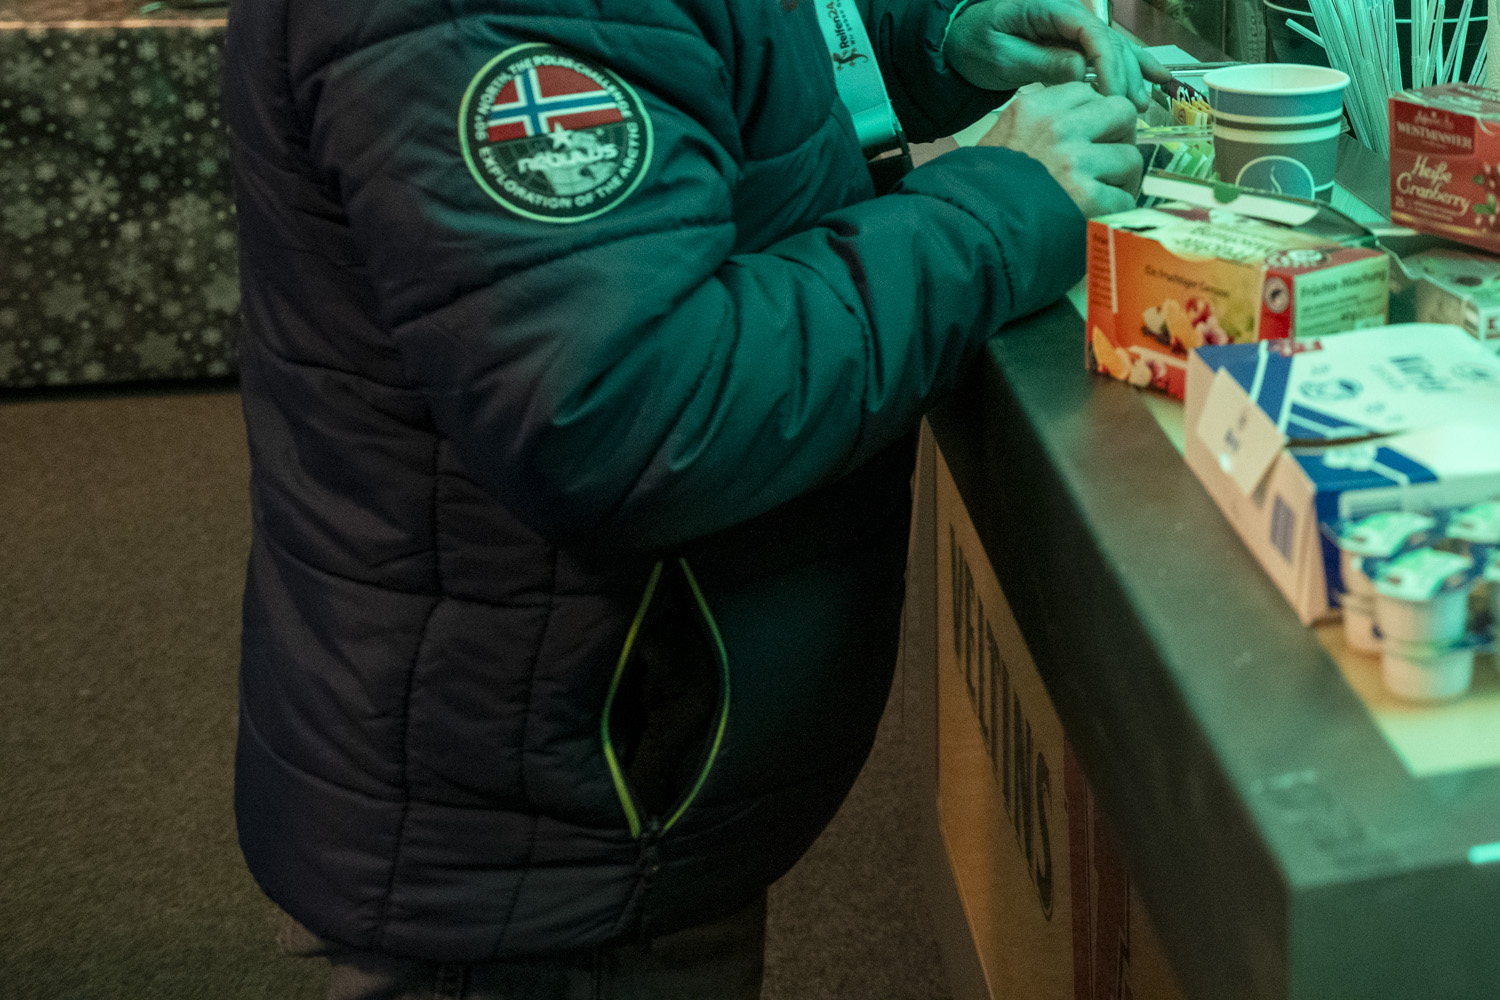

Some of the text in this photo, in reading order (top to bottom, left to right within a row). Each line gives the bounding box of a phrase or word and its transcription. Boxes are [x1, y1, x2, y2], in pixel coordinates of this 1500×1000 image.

[508, 58, 533, 74] THE
[532, 55, 574, 69] POLAR
[573, 62, 633, 118] CHALLENGE
[478, 146, 573, 210] EXPLORATION
[574, 192, 596, 207] OF
[595, 175, 625, 199] THE
[1395, 171, 1472, 217] Cranberry
[948, 522, 1054, 921] VELTINS
